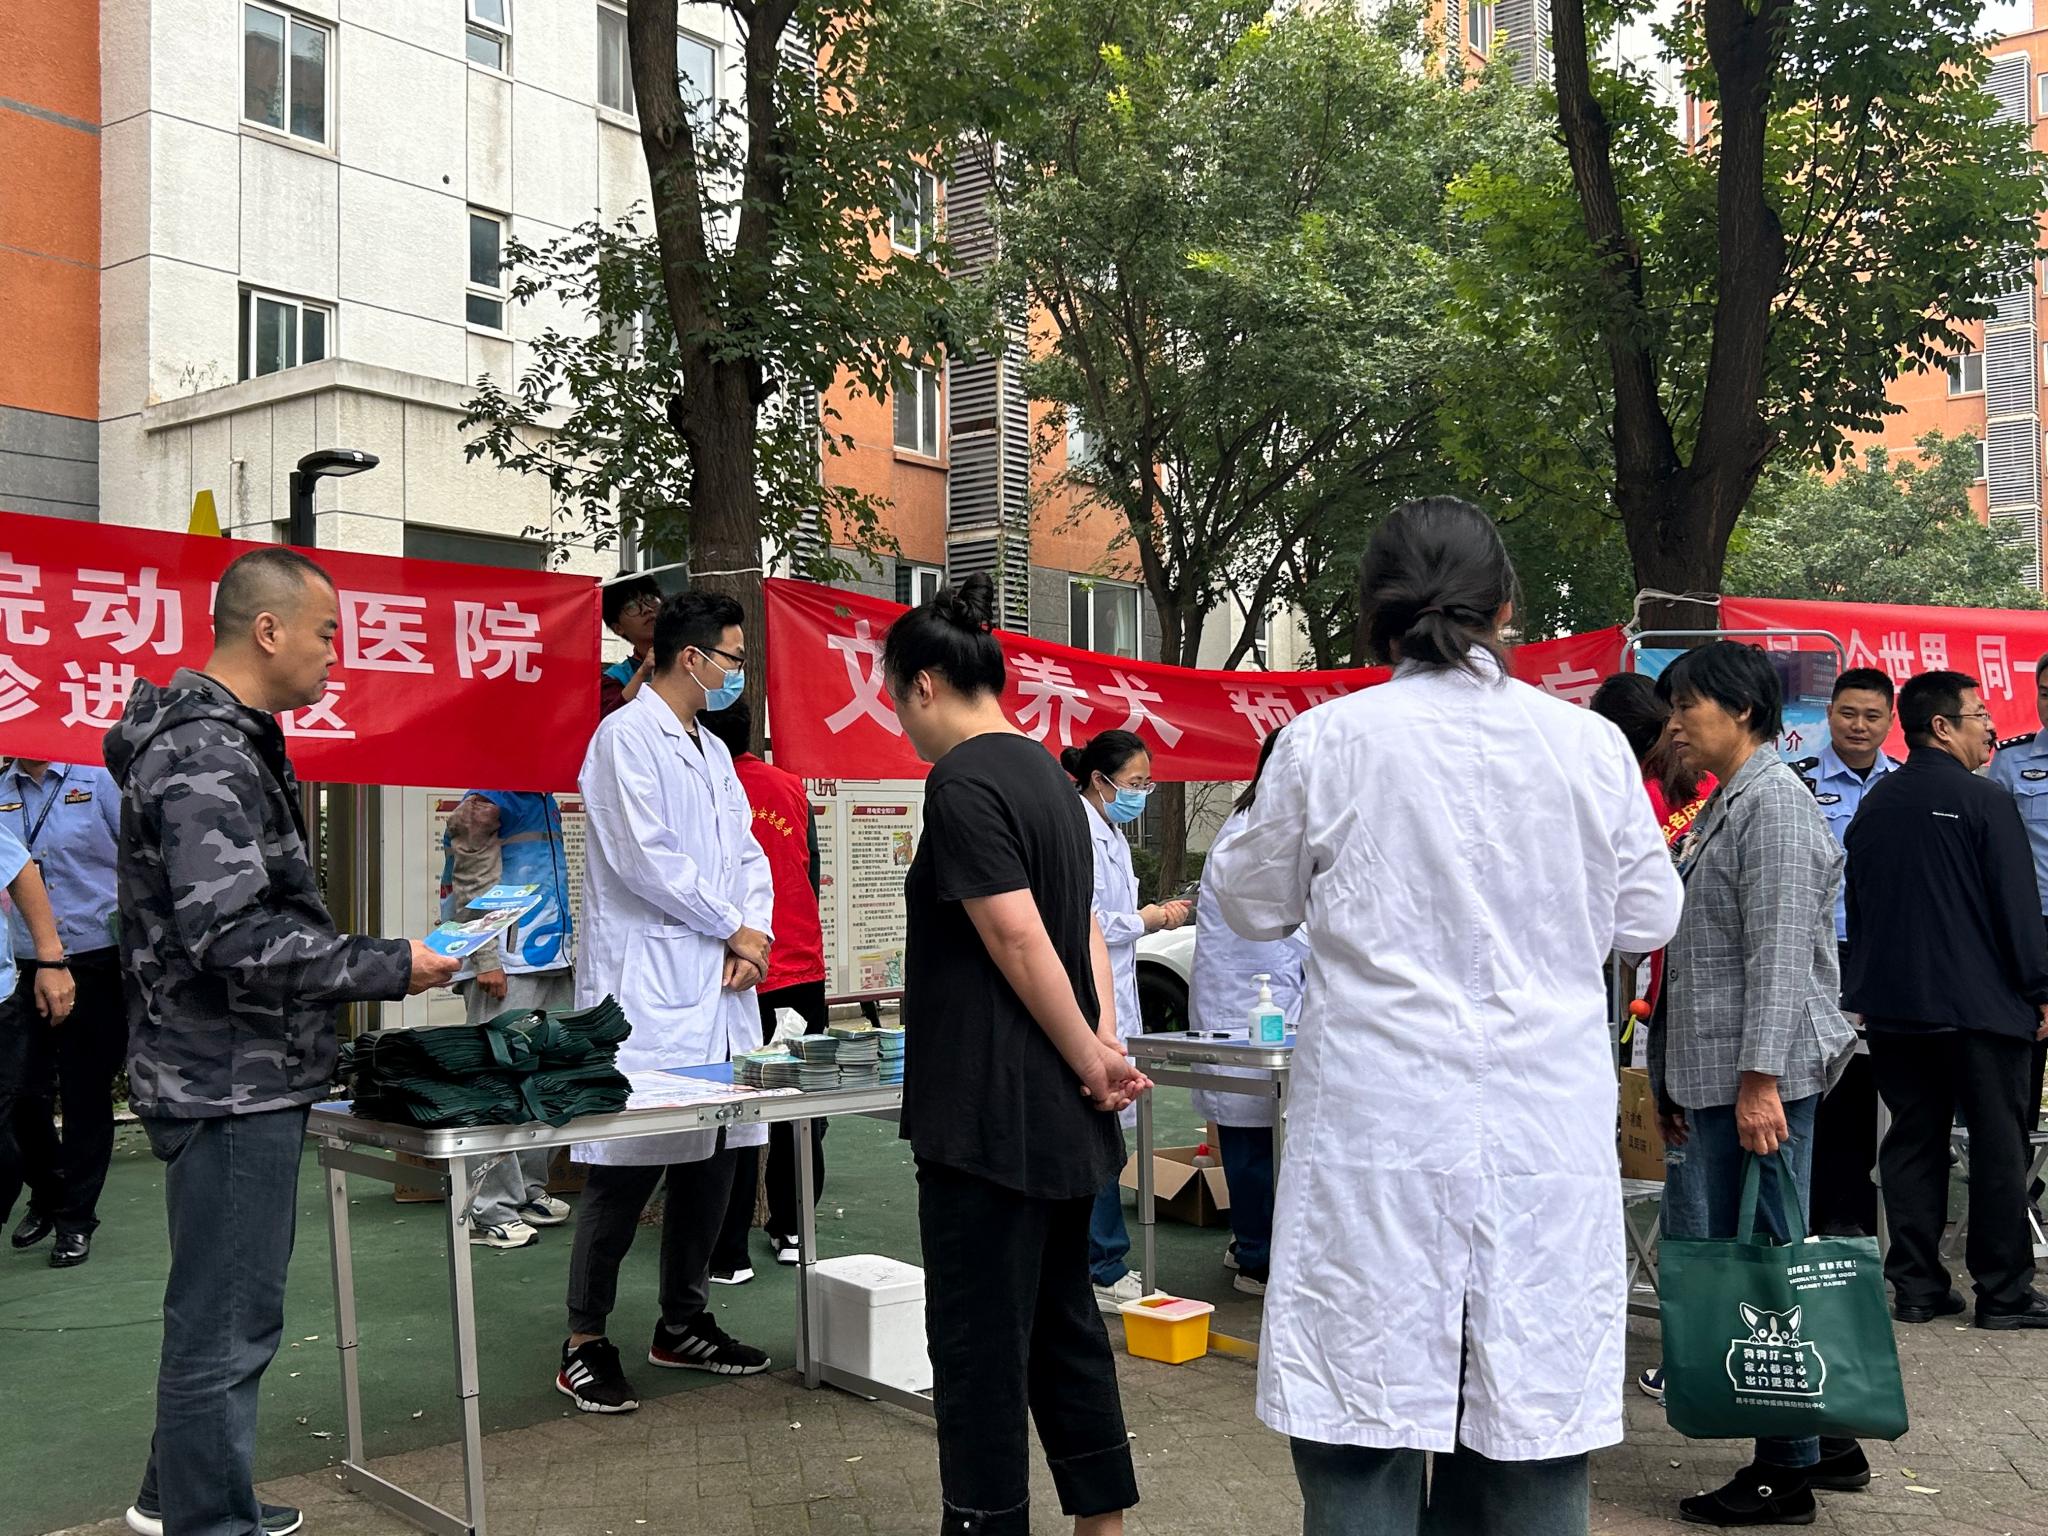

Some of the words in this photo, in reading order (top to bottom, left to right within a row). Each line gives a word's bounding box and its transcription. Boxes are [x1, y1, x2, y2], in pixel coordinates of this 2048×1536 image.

[0, 552, 544, 683] 动医院
[824, 619, 1184, 749] 文养犬
[1766, 627, 1949, 695] 个世界
[0, 654, 356, 739] 进区
[1743, 1348, 1804, 1362] 狗狗打一针
[1744, 1362, 1807, 1376] 家人都安心
[1745, 1375, 1809, 1389] 出门更放心
